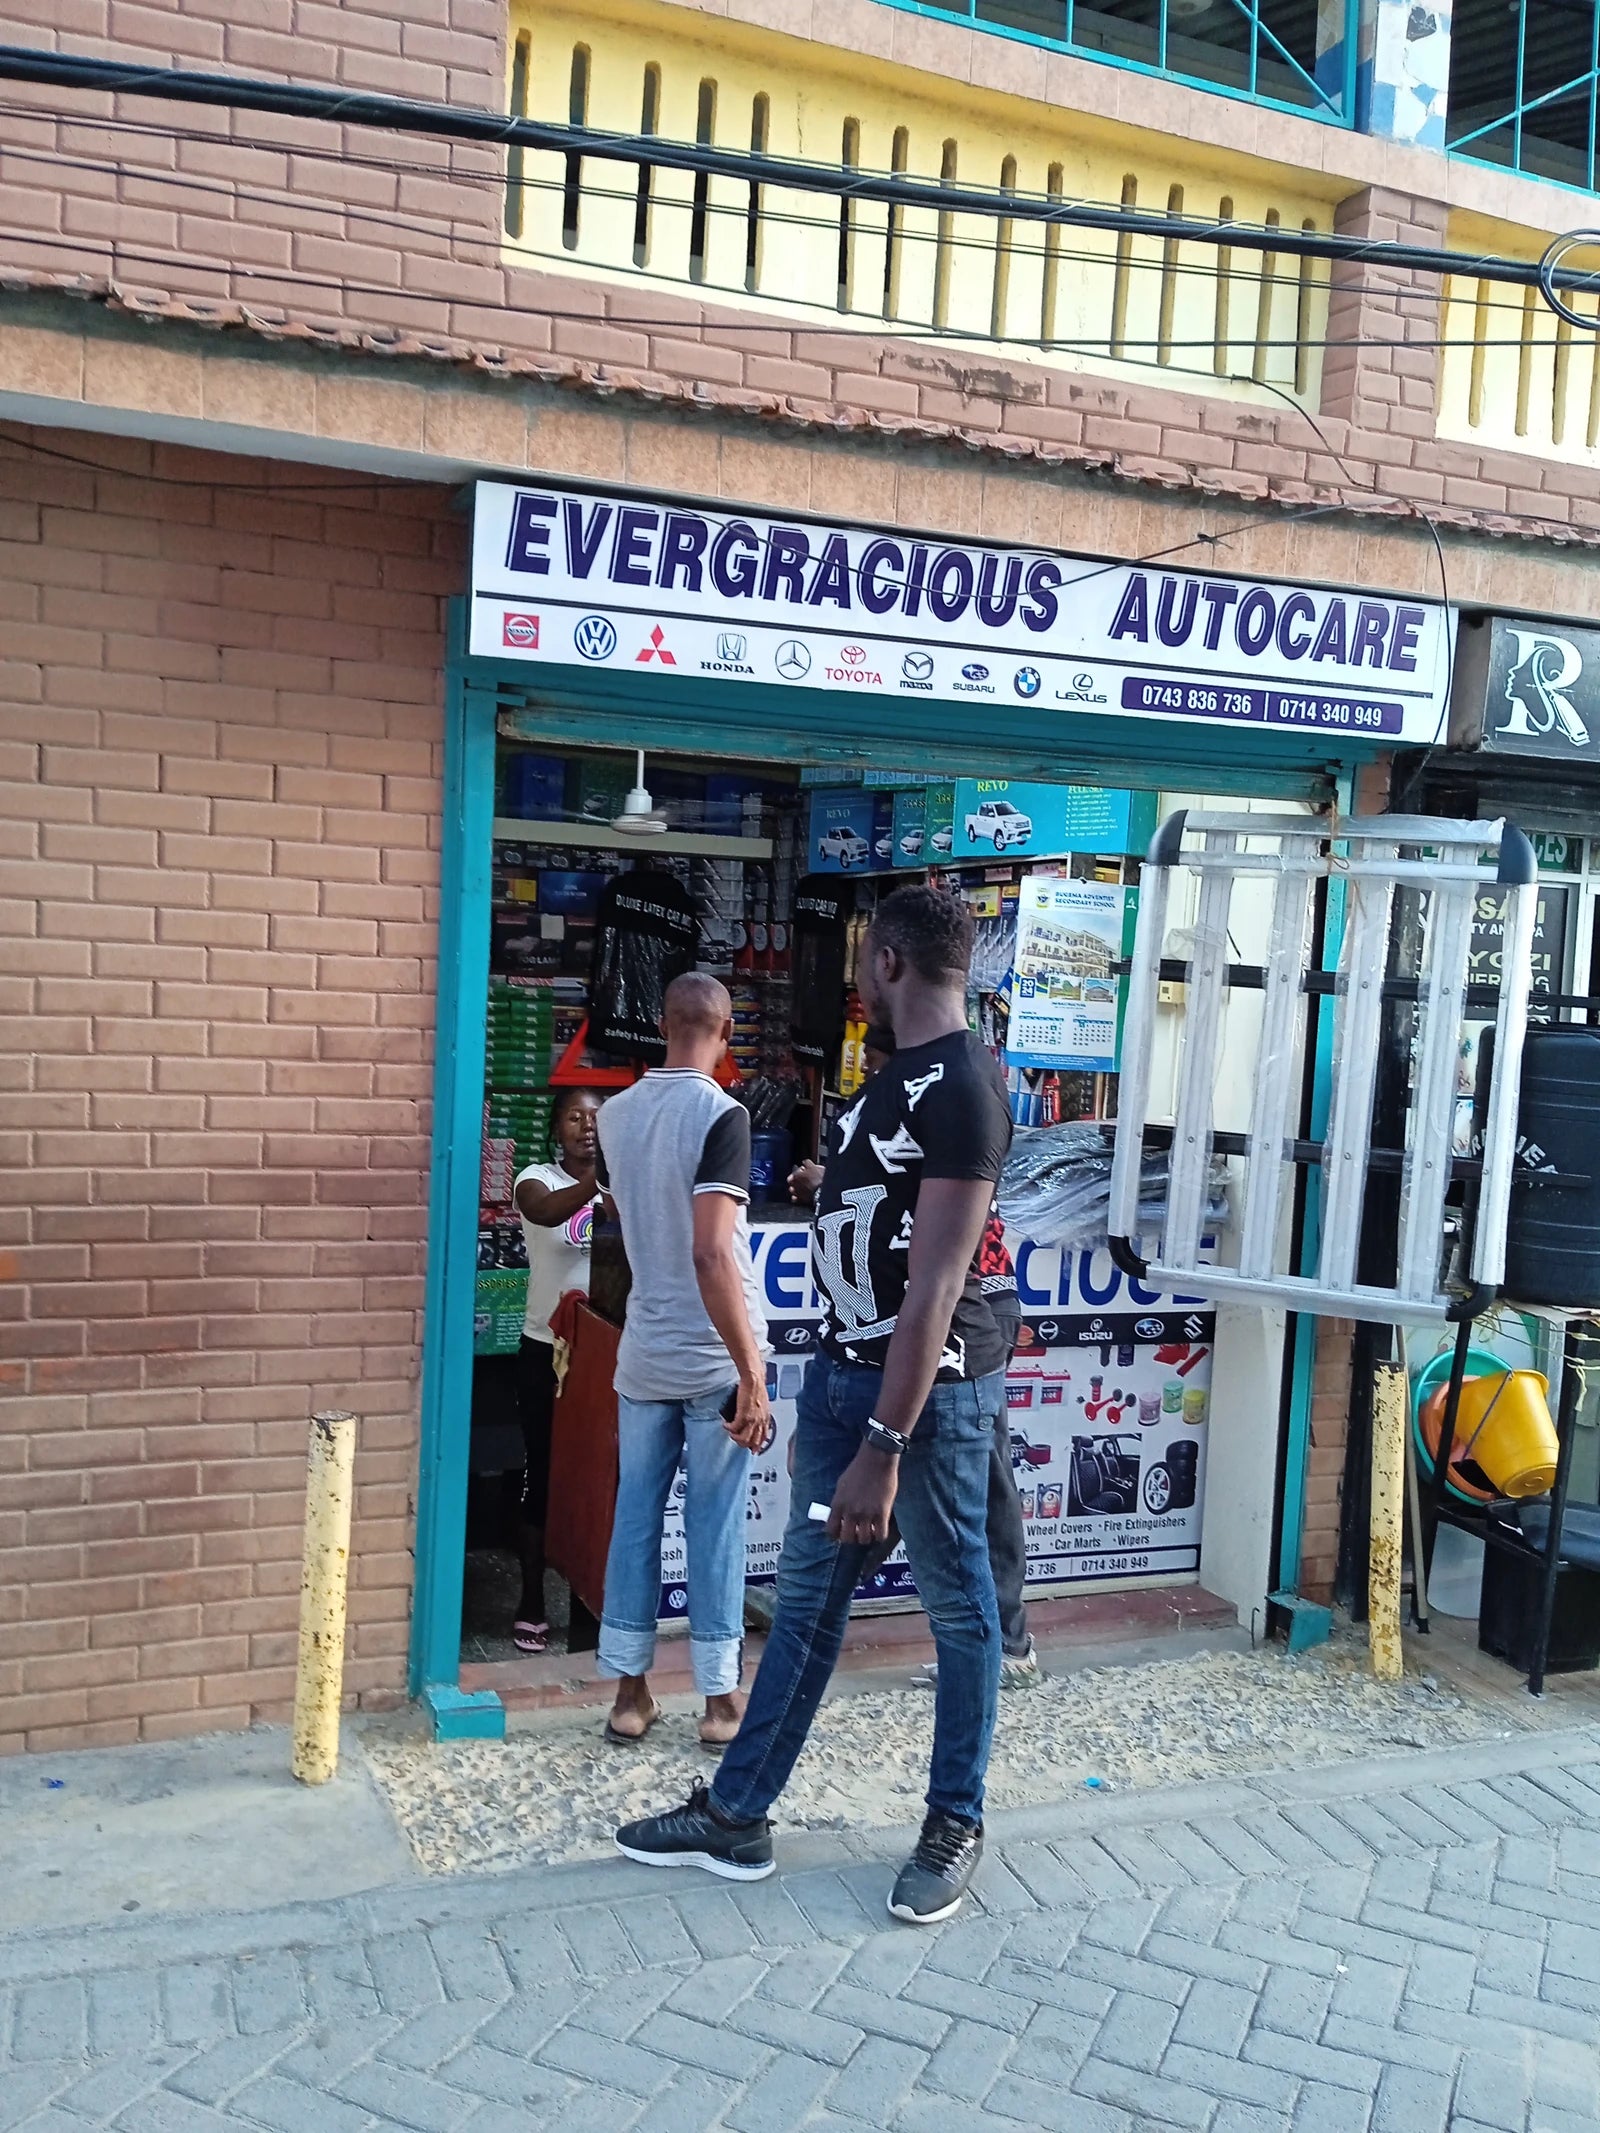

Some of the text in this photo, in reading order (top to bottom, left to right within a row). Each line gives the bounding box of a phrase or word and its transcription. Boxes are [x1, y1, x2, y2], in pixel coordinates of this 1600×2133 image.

[505, 492, 1426, 672] EVERGRACIOUS AUTOCARE
[700, 661, 755, 675] HONDA
[824, 667, 883, 685] TOYOTA
[899, 680, 933, 691] mazda
[952, 682, 995, 694] SUBARU
[1055, 690, 1108, 704] LEXUS
[1142, 684, 1252, 715] 0743 836 736
[1279, 698, 1382, 728] 0714 340 949
[977, 780, 1008, 793] REVO
[639, 1035, 667, 1046] comfo
[1078, 1331, 1113, 1341] ISUZU
[1027, 1523, 1058, 1537] Wheel
[1060, 1521, 1093, 1535] Covers
[1125, 1516, 1187, 1530] Extinguishers
[745, 1540, 782, 1555] aners
[1025, 1534, 1150, 1552] ers Car Marts Wipers
[661, 1546, 683, 1561] ash
[1038, 1562, 1057, 1575] 736
[1081, 1555, 1149, 1572] 0714 340 949
[662, 1566, 688, 1581] heel
